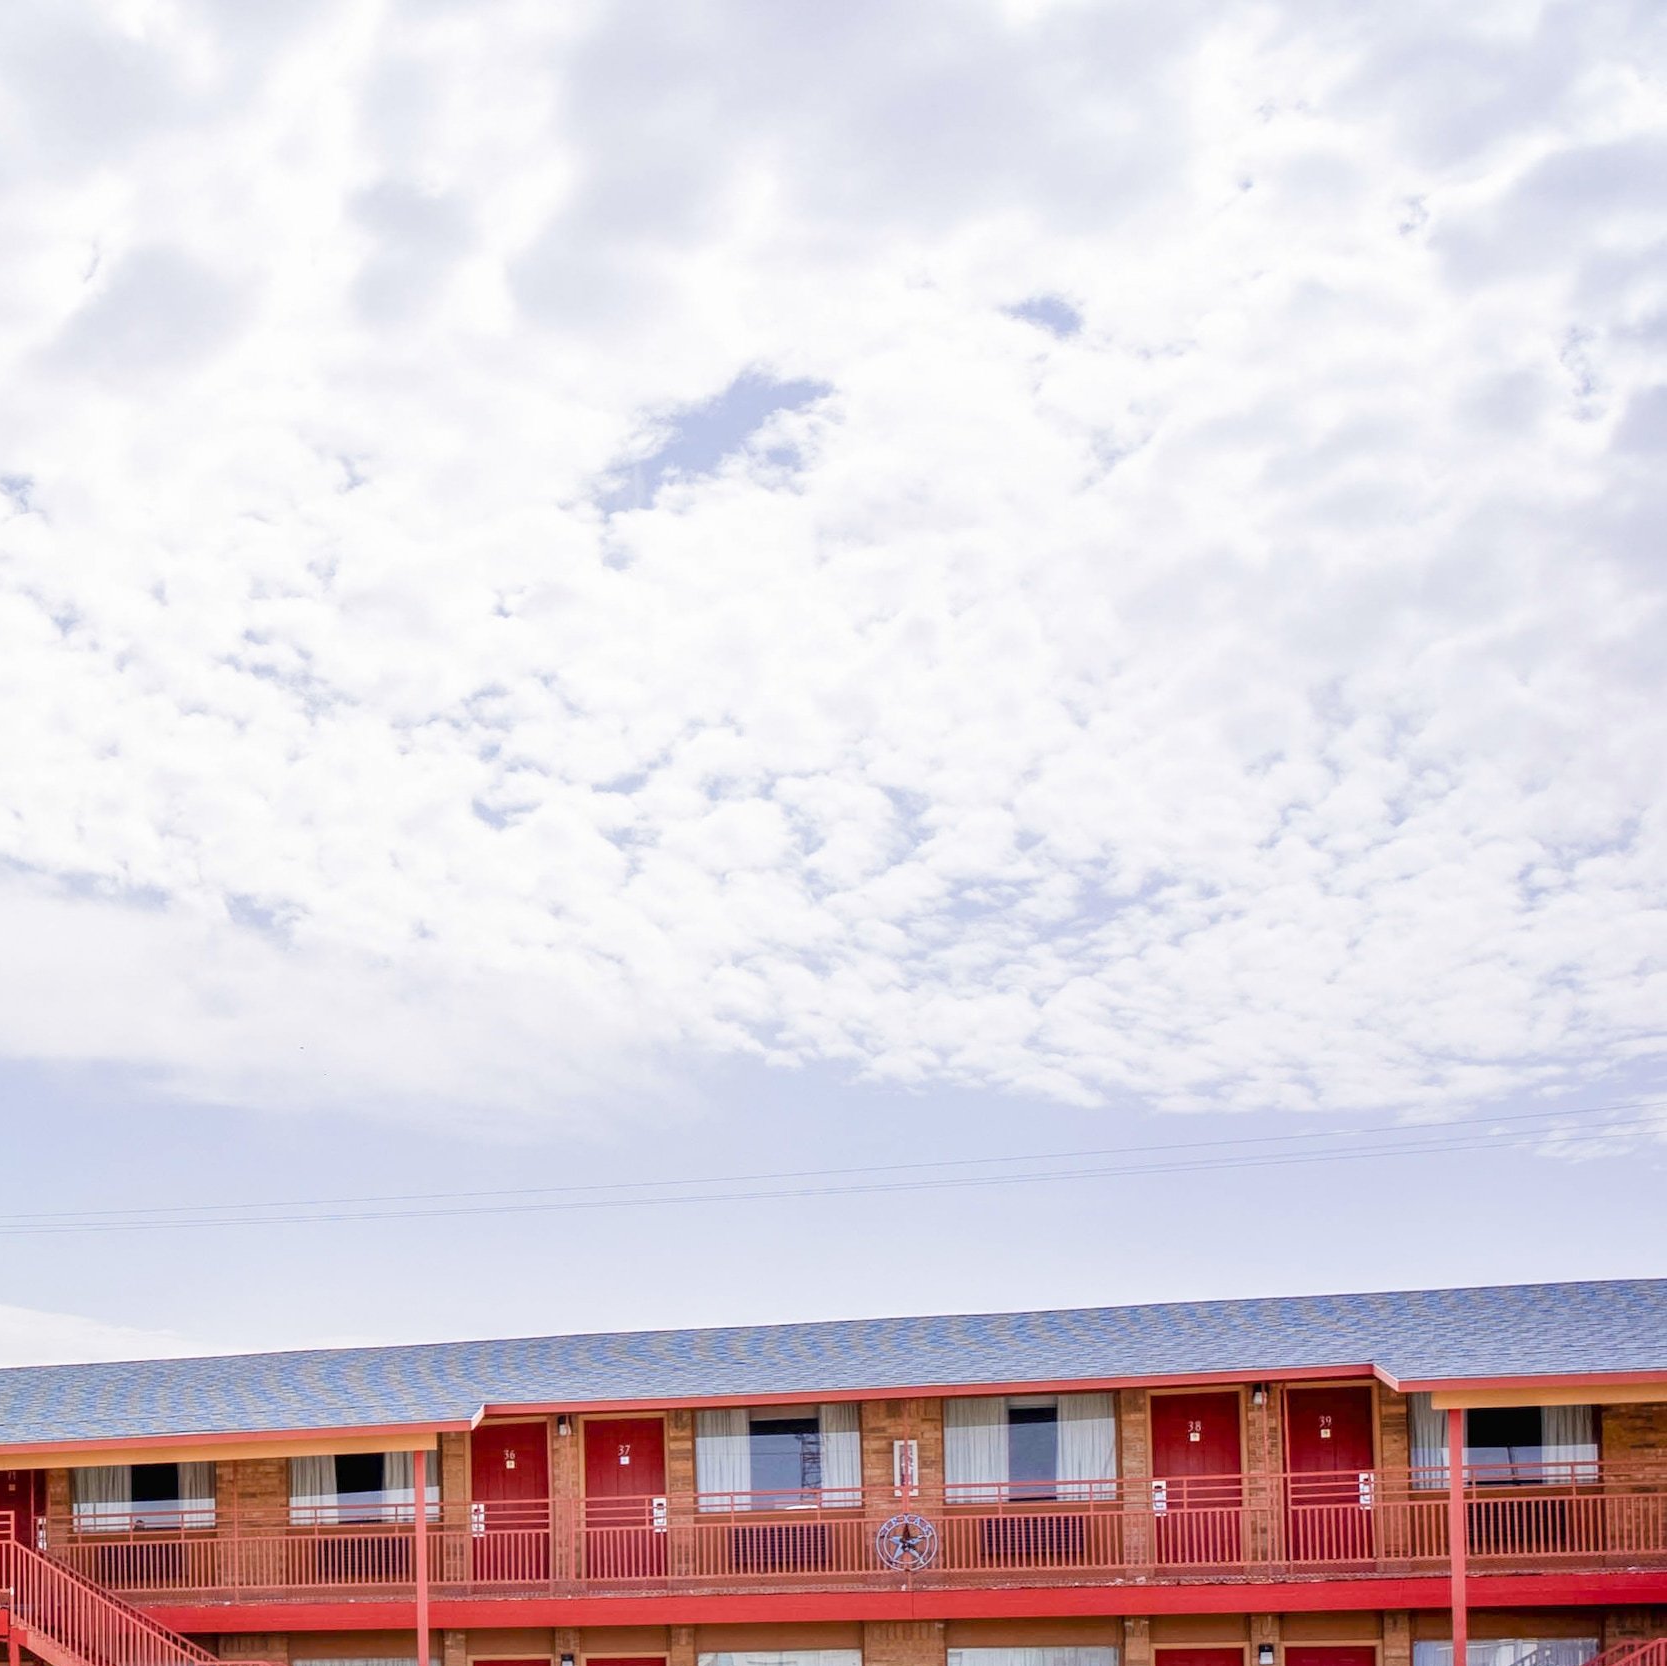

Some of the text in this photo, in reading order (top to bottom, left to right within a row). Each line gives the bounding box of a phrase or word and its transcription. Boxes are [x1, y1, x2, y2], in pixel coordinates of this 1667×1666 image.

[1187, 1420, 1201, 1432] 38
[1318, 1415, 1332, 1428] 39
[503, 1449, 516, 1460] 36
[618, 1444, 631, 1456] 37
[879, 1514, 935, 1537] TEXAS
